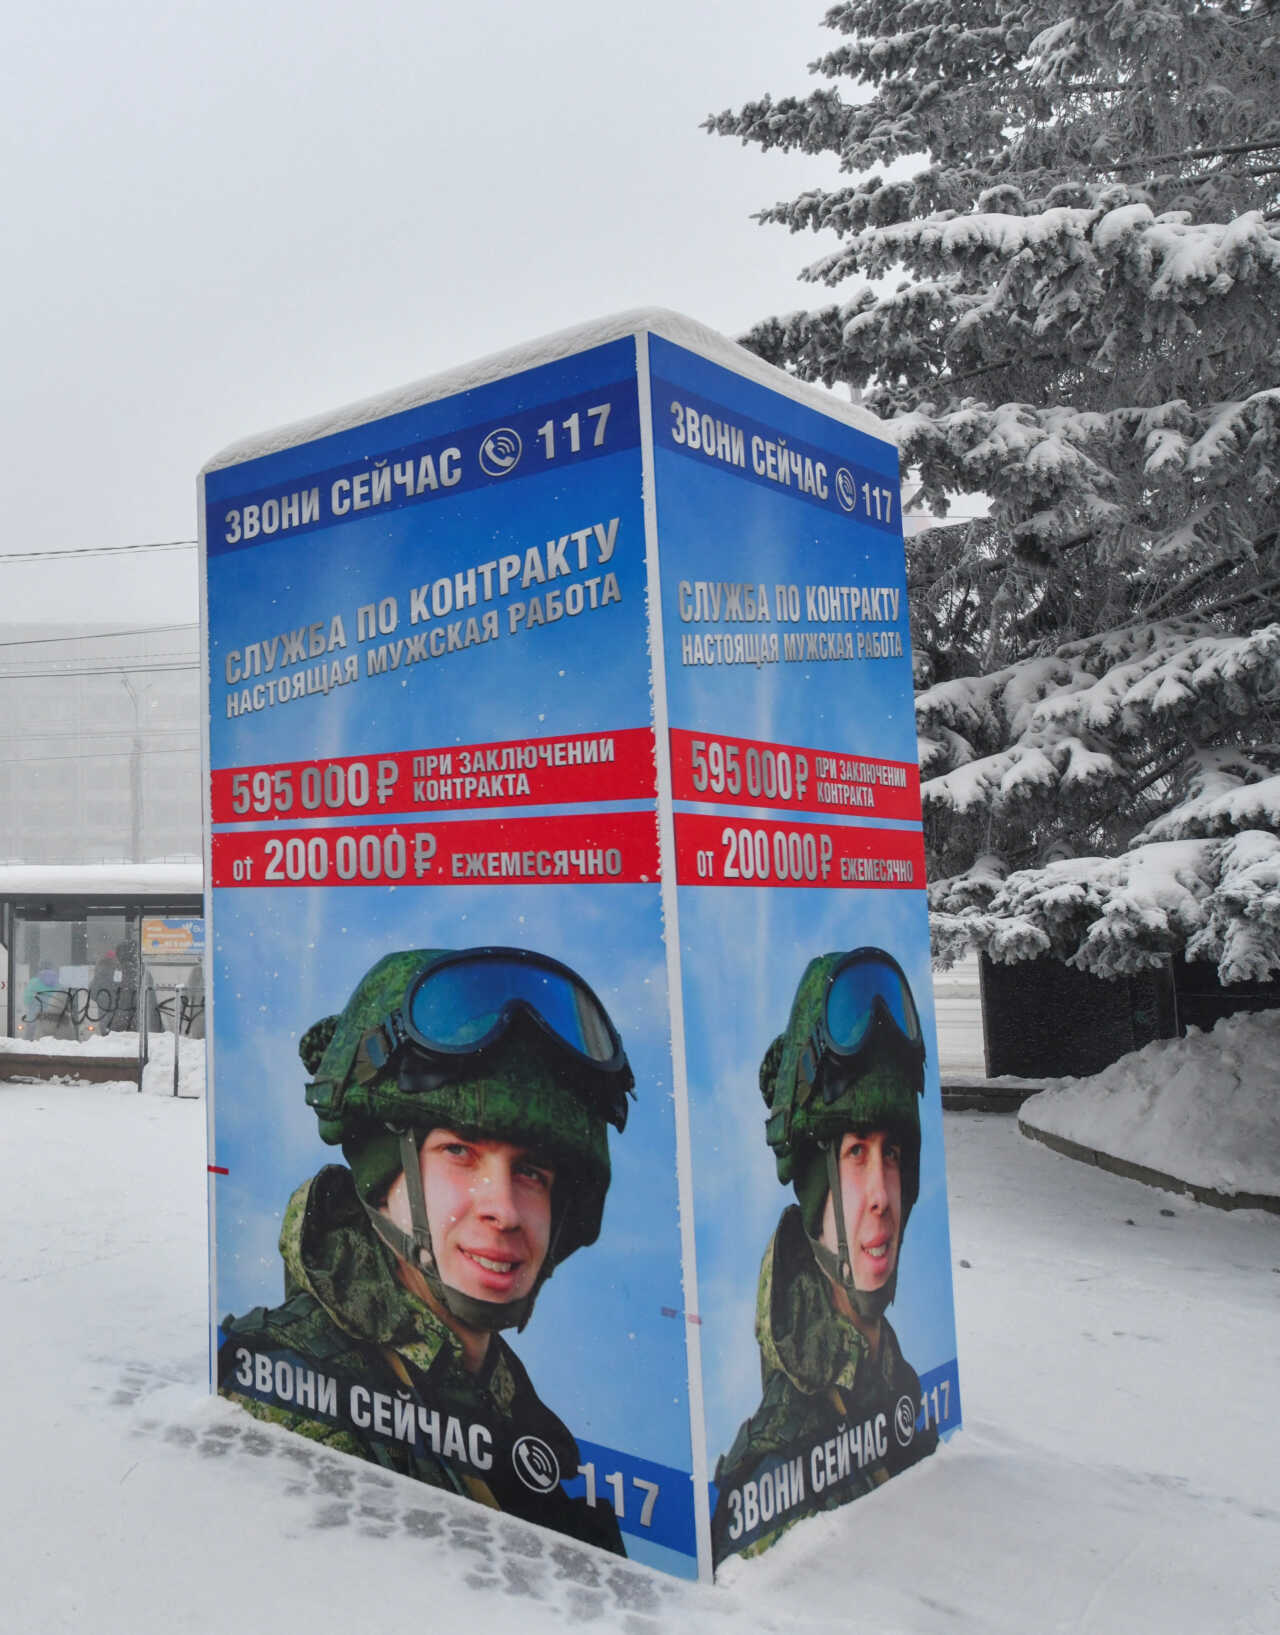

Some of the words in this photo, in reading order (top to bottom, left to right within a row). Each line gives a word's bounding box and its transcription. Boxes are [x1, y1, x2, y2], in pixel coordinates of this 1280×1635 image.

[225, 488, 319, 544] ЗВОНИ
[331, 447, 462, 516] СЕЙЧАС
[538, 404, 612, 460] 117
[670, 401, 746, 469] ЗВОНИ
[752, 436, 829, 500] СЕЙЧАС
[861, 482, 893, 524] 117
[225, 615, 346, 685] СЛУЖБА
[357, 597, 397, 642] ПО
[410, 518, 619, 625] КОНТРАКТУ
[678, 580, 770, 622] СЛУЖБА
[775, 584, 801, 623] ПО
[805, 585, 899, 623] КОНТРАКТУ
[226, 654, 358, 718] НАСТОЯЩАЯ
[367, 613, 499, 677] МУЖСКАЯ
[508, 573, 622, 634] РАБОТА
[682, 633, 779, 669] НАСТОЯЩАЯ
[783, 632, 854, 662] МУЖСКАЯ
[857, 632, 903, 658] РАБОТА
[412, 753, 452, 778] ПРИ
[459, 738, 615, 774] ЗАКЛЮЧЕНИИ
[816, 757, 836, 779] ПРИ
[840, 759, 907, 788] ЗАКЛЮЧЕНИИ
[413, 773, 531, 803] КОНТРАКТА
[816, 782, 874, 807] КОНТРАКТА
[451, 848, 622, 879] ЕЖЕМЕСЯЧНО
[840, 857, 913, 882] ЕЖЕМЕСЯЧНО
[236, 1347, 337, 1417] ЗВОНИ
[350, 1384, 493, 1471] СЕЙЧАС
[578, 1462, 659, 1527] 117
[728, 1456, 805, 1540] ЗВОНИ
[811, 1413, 888, 1493] СЕЙЧАС
[921, 1380, 950, 1430] 117
